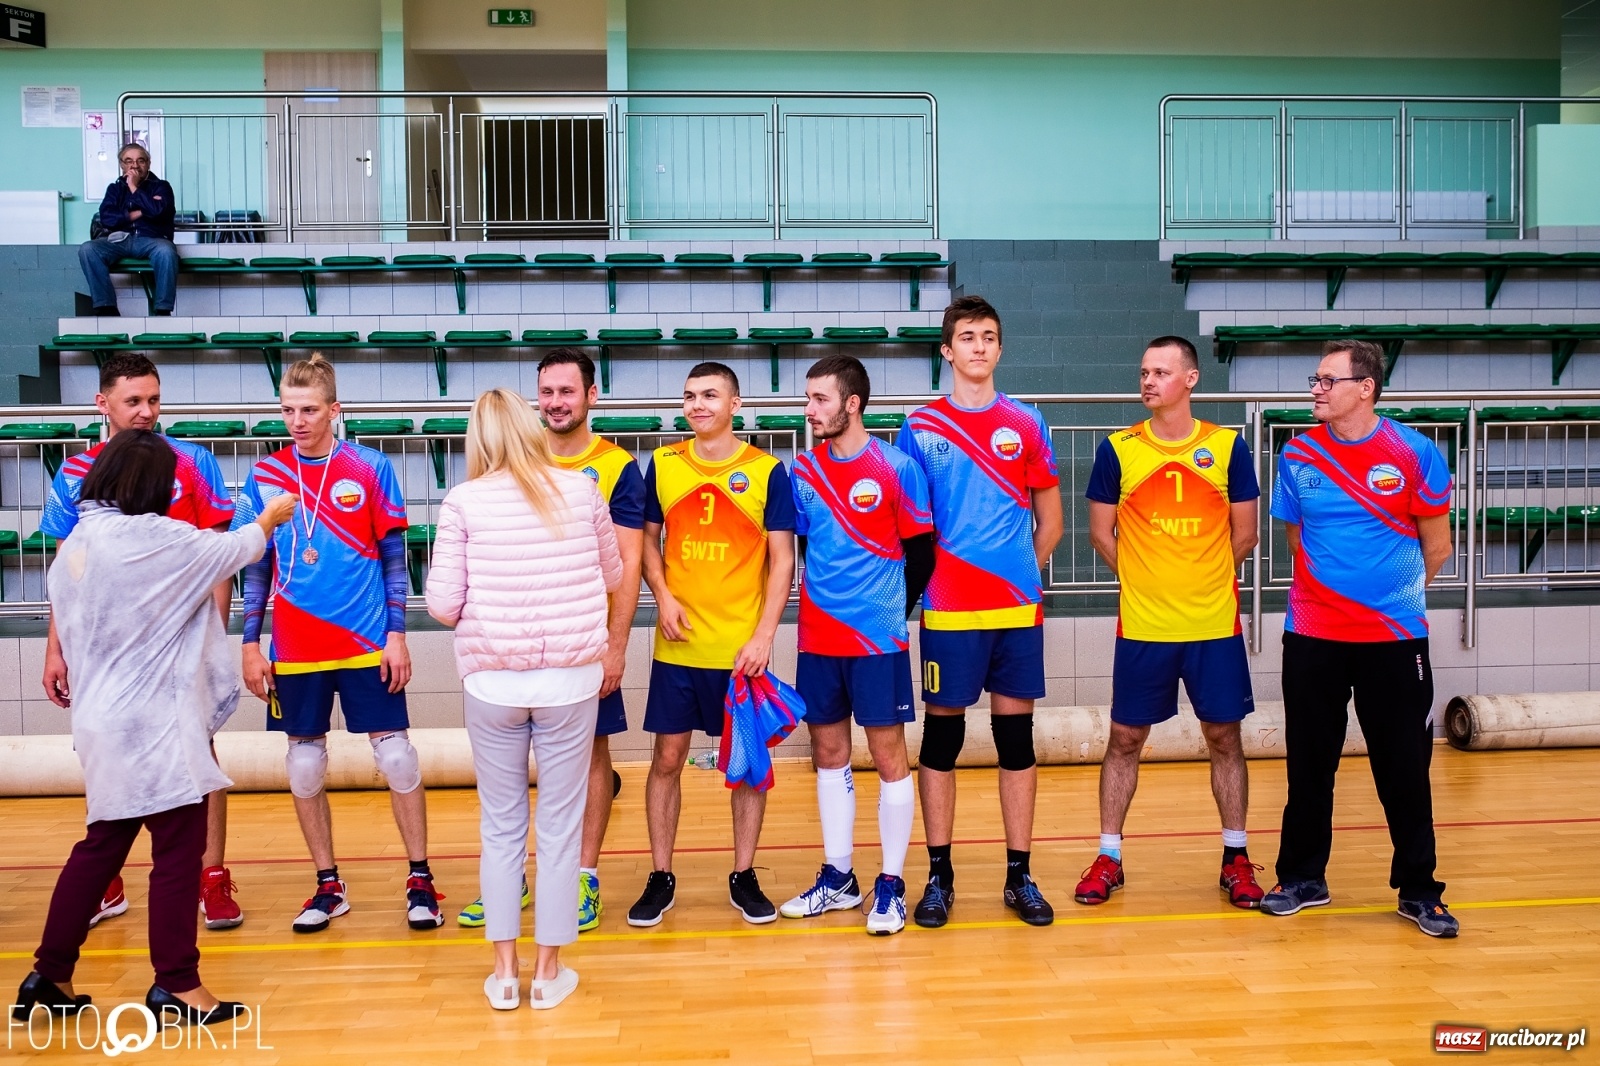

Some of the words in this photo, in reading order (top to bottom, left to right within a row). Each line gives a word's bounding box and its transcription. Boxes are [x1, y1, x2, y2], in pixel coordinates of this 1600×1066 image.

[4, 7, 35, 19] SEKTOR
[9, 17, 32, 38] F
[1165, 470, 1183, 502] 7
[699, 492, 715, 525] 3
[1150, 512, 1202, 537] ŚWIT
[681, 534, 730, 562] ŚWIT
[923, 659, 940, 694] 10
